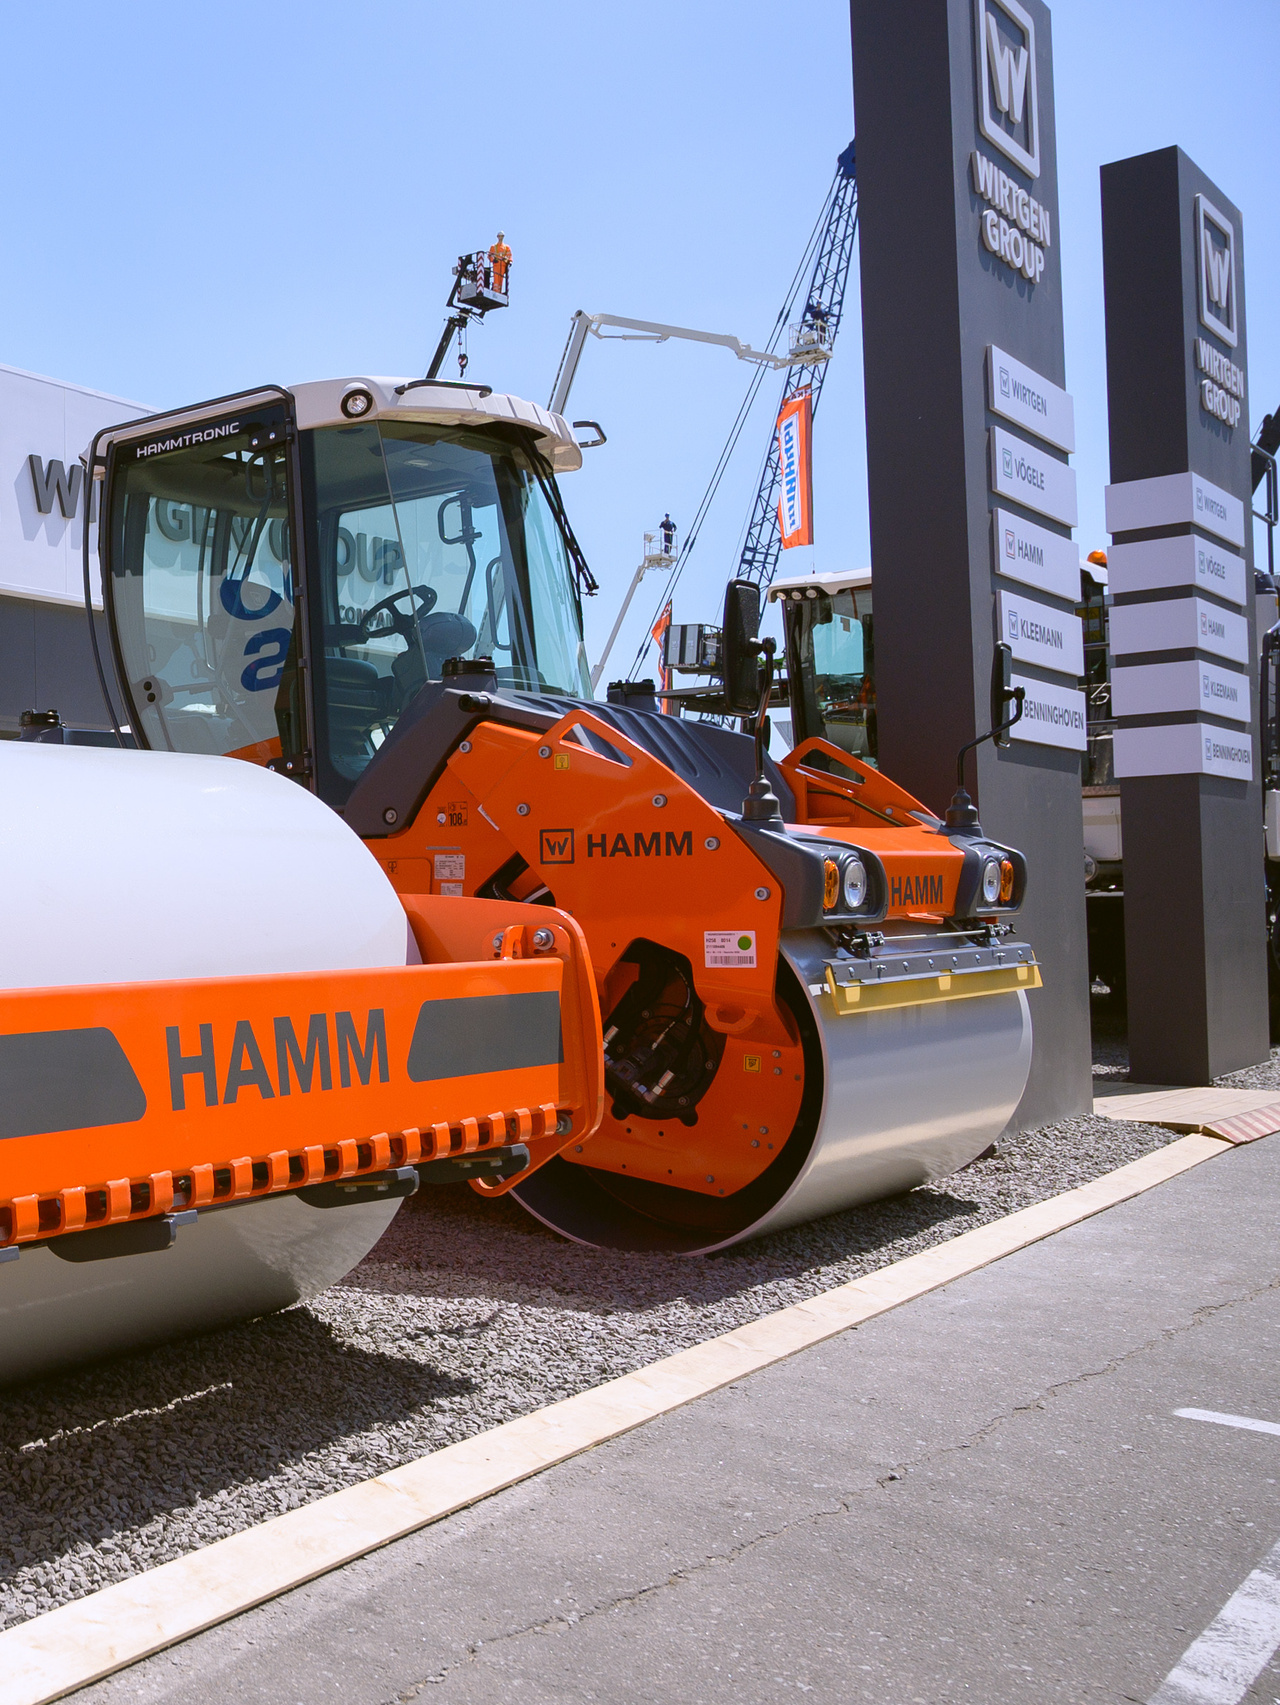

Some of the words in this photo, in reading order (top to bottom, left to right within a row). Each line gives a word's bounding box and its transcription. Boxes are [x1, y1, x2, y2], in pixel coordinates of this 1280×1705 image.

[971, 150, 1051, 247] WIRTGEN
[982, 209, 1044, 283] GROUP
[1196, 337, 1245, 399] WIRTGEN
[1012, 378, 1047, 416] WIRTGEN
[1202, 379, 1241, 429] GROUP
[136, 422, 240, 458] HAMMTRONIC
[1015, 457, 1045, 491] VÖGELE
[1204, 495, 1227, 521] WIRTGEN
[1018, 539, 1044, 567] HAMM
[1020, 618, 1063, 649] KLEEMANN
[1208, 619, 1225, 639] HAMM
[1210, 681, 1238, 702] KLEEMANN
[1024, 699, 1084, 730] BENNINGHOVEN
[1213, 743, 1251, 764] BENNINGHOVEN
[449, 812, 463, 826] 108
[587, 831, 693, 857] HAMM
[891, 875, 943, 906] HAMM
[166, 1008, 390, 1111] HAMM
